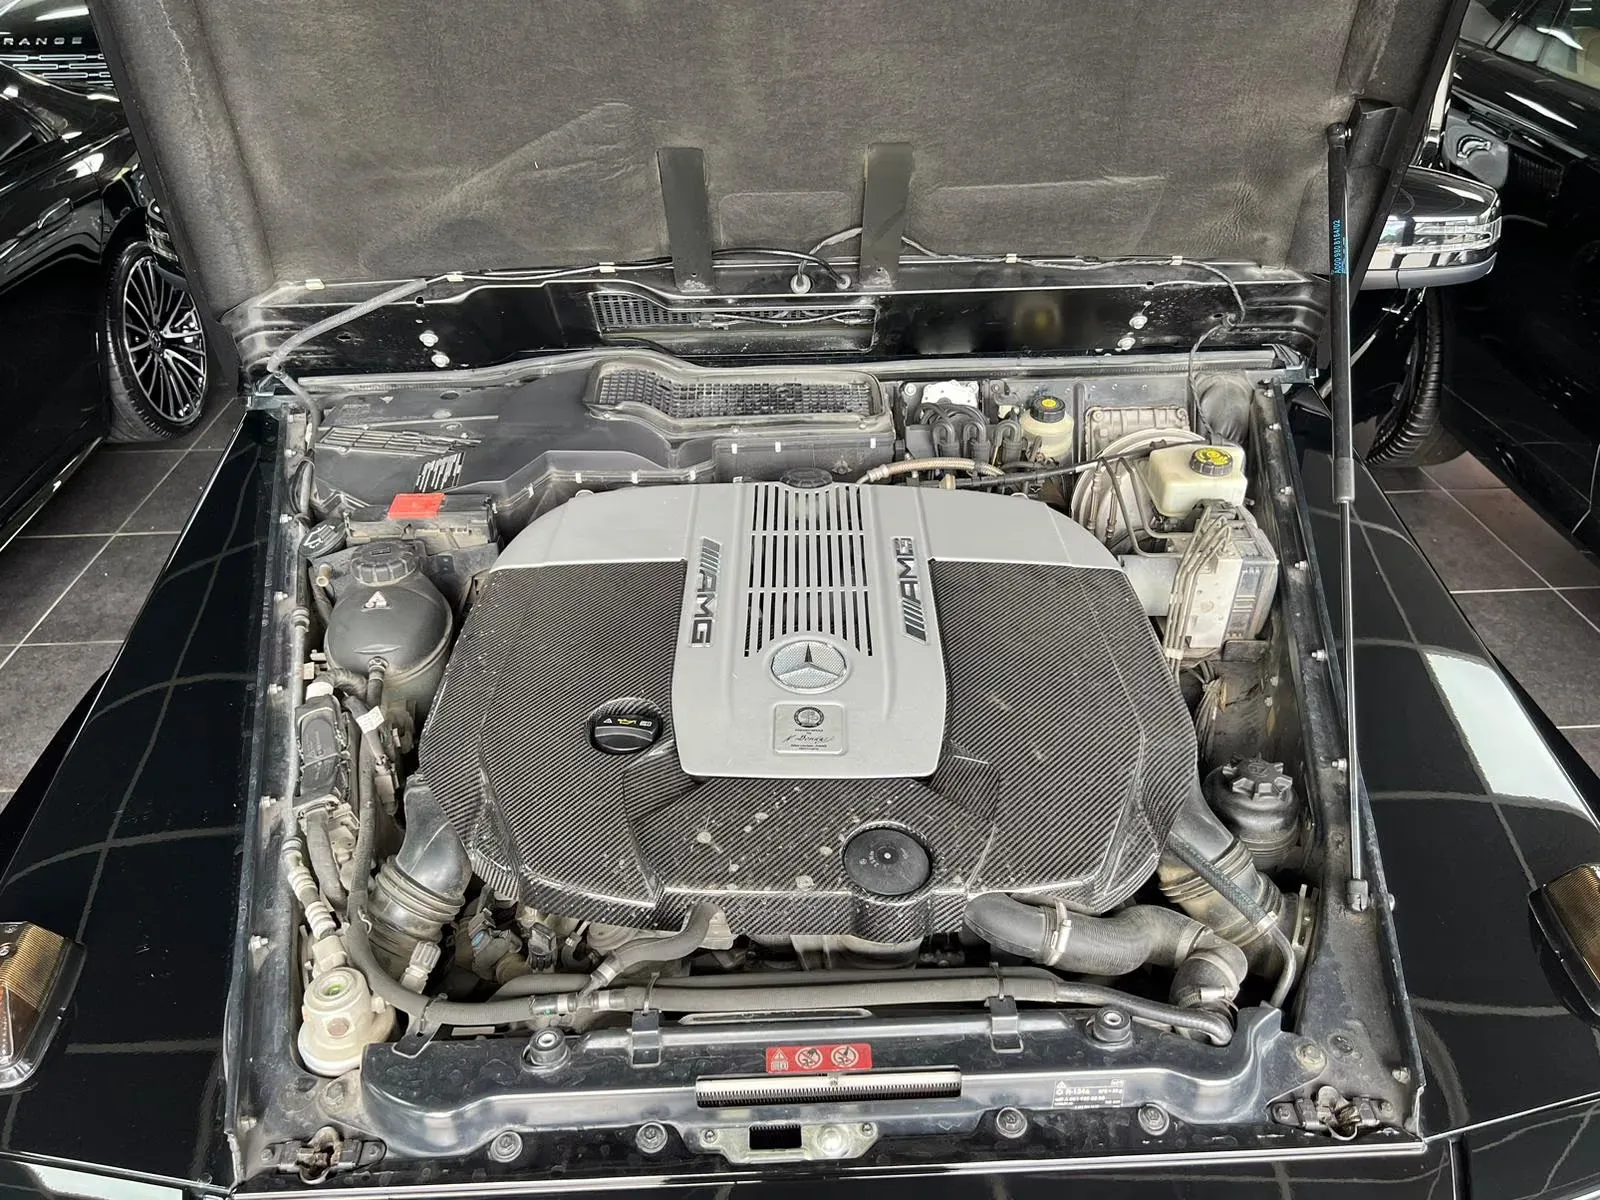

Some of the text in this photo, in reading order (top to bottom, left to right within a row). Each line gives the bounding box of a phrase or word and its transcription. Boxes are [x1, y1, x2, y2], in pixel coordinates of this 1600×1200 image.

[3, 36, 83, 46] RANGE
[896, 537, 922, 604] AMG
[691, 569, 717, 644] AMG
